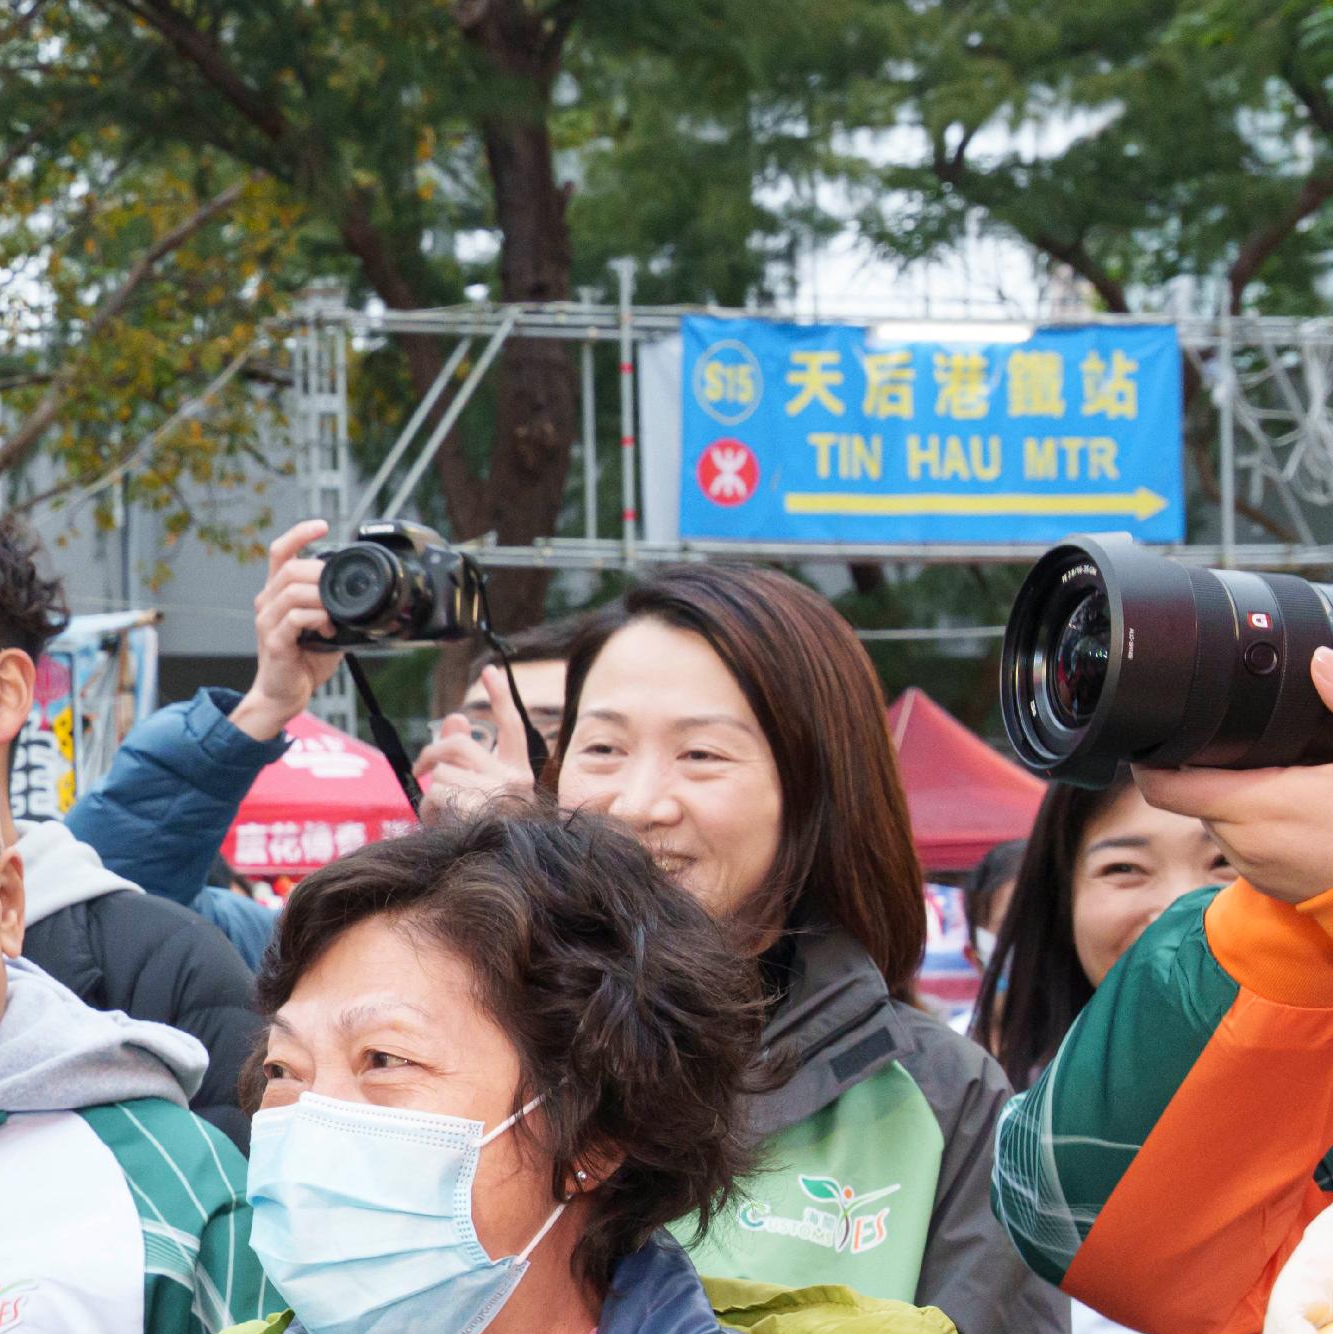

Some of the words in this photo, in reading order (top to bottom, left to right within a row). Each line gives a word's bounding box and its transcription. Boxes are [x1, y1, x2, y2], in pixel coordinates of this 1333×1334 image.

[703, 361, 754, 404] S15
[785, 349, 1139, 421] 天后港鐵站
[807, 432, 882, 480] TIN
[906, 434, 1002, 480] HAU
[1024, 437, 1119, 480] MTR
